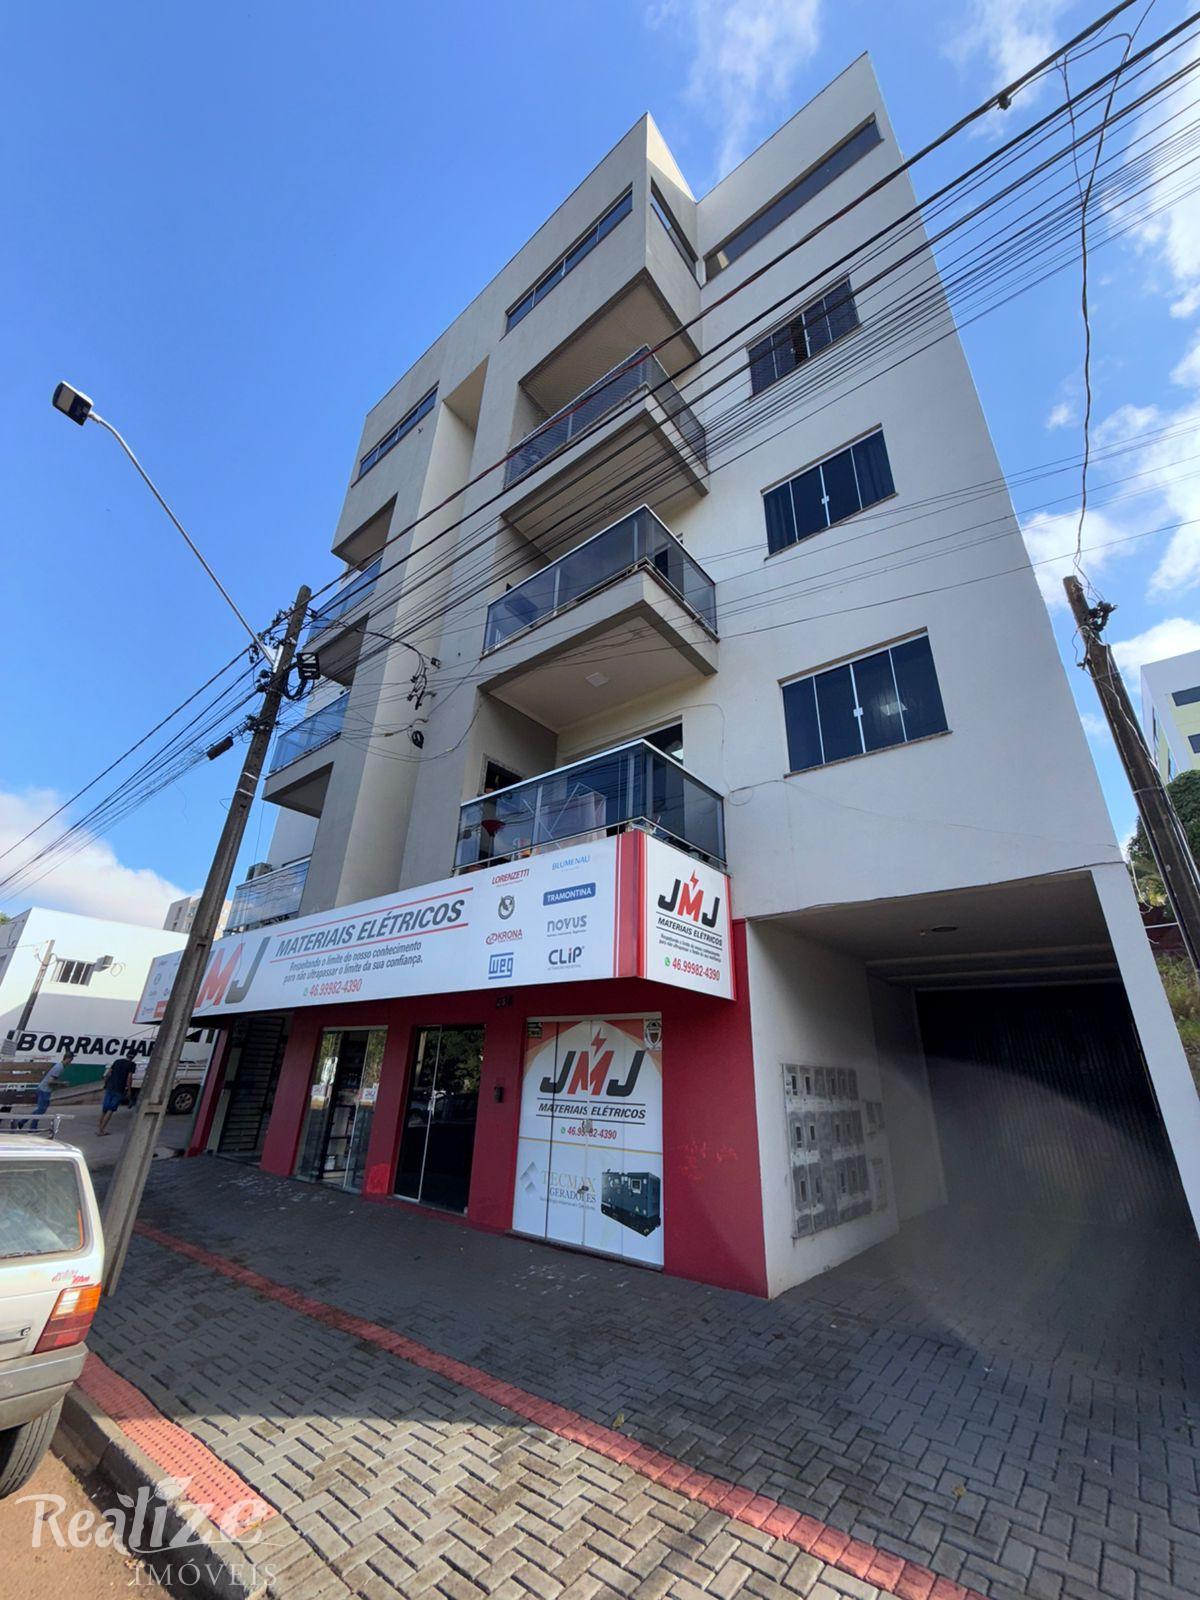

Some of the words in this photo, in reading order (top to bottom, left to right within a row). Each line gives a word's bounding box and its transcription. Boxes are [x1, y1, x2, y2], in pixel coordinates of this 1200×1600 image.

[551, 855, 591, 871] BLUMENAU
[491, 868, 530, 885] LORENZETTI
[546, 887, 592, 903] TRAMONTINA
[657, 877, 721, 928] JMJ
[275, 923, 357, 957] MATERIAIS
[357, 899, 465, 941] ELÉTRICOS
[497, 929, 523, 941] KRONA
[657, 917, 693, 936] MATERIAIS
[353, 950, 372, 961] nosso
[372, 941, 422, 959] conhecimento
[195, 937, 271, 1008] MJ
[307, 966, 338, 981] ultrapassar
[343, 962, 361, 974] limite
[362, 961, 372, 972] da
[372, 960, 385, 970] sua
[386, 953, 423, 969] confiança.
[672, 957, 721, 981] 46.99982-4390
[309, 978, 363, 998] 46.99982-4390
[539, 1050, 646, 1097] JMJ
[538, 1103, 588, 1116] MATERIAIS
[590, 1105, 647, 1119] ELÉTRICOS
